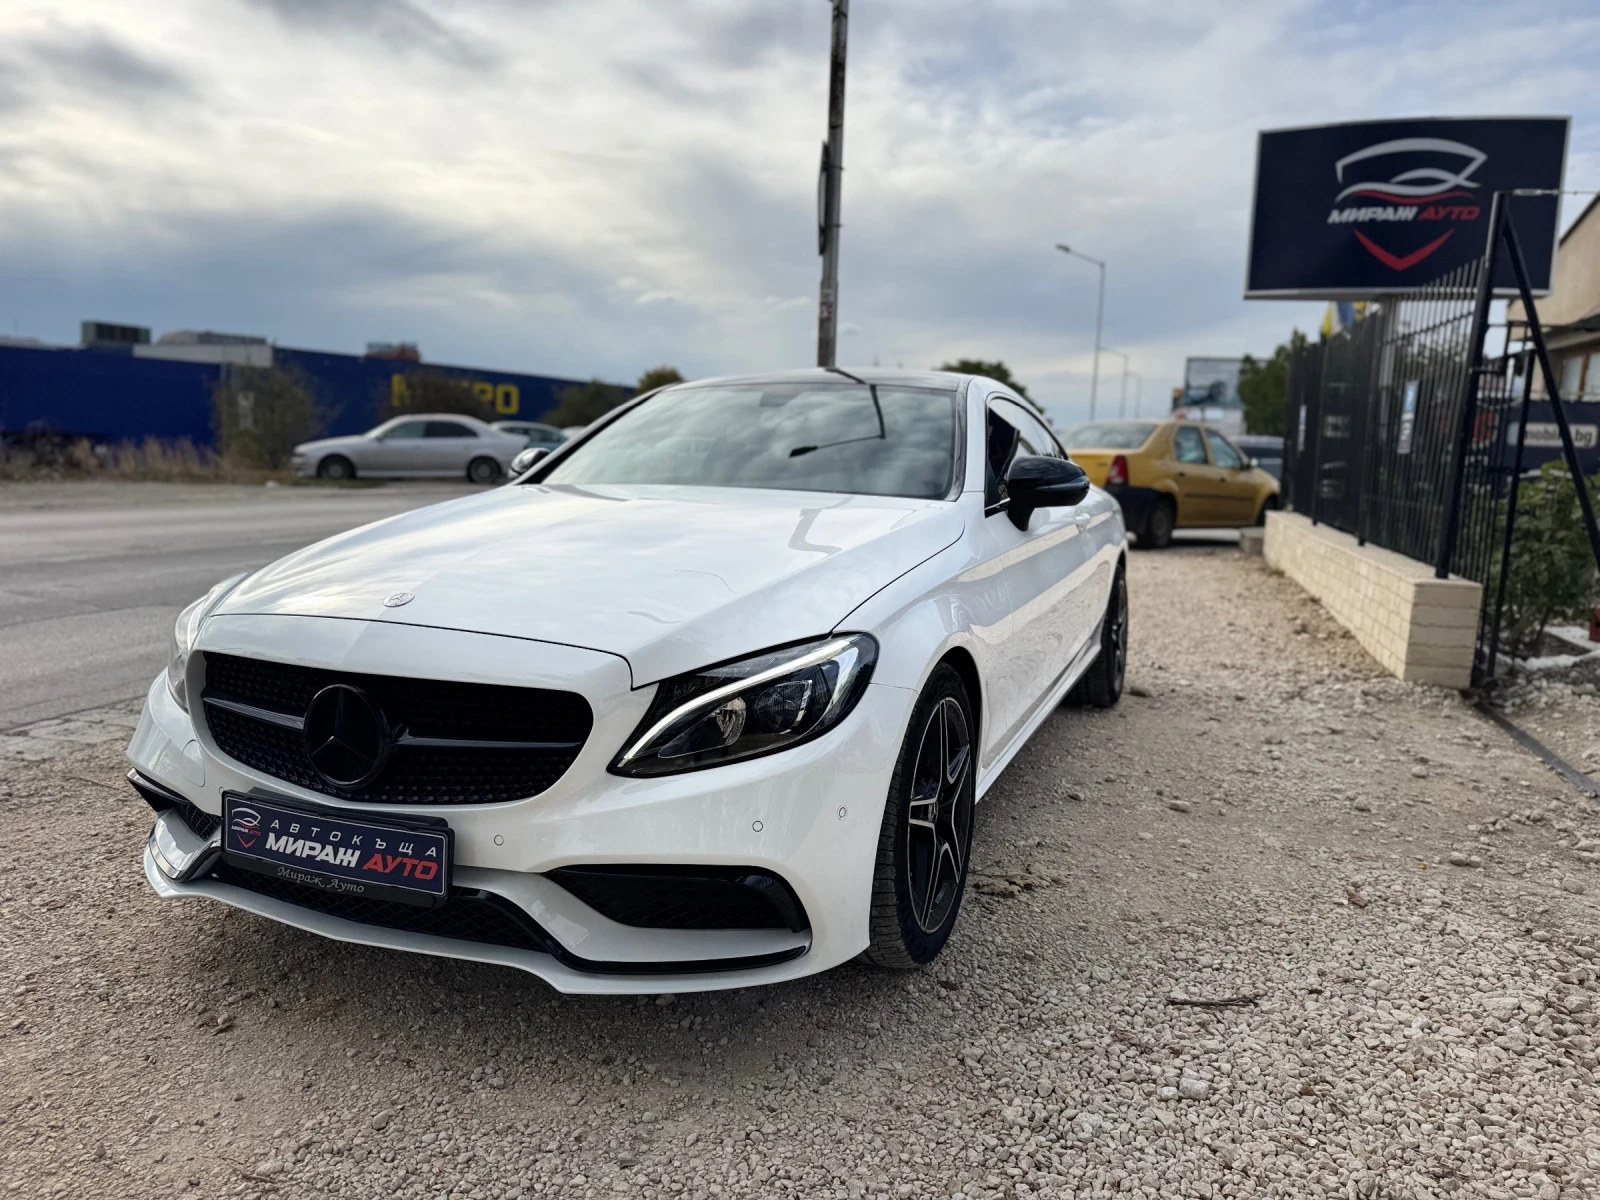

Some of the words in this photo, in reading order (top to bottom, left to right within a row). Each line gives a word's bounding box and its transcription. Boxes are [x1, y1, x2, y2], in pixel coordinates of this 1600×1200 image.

[1327, 205, 1419, 225] МИРАЖ
[1418, 205, 1481, 221] АУТО
[270, 819, 437, 858] АВТОКЪЩА
[265, 832, 361, 868] МИРАЖ
[362, 853, 439, 881] АУТО
[277, 866, 325, 888] Мираж
[327, 878, 365, 893] Ауто
